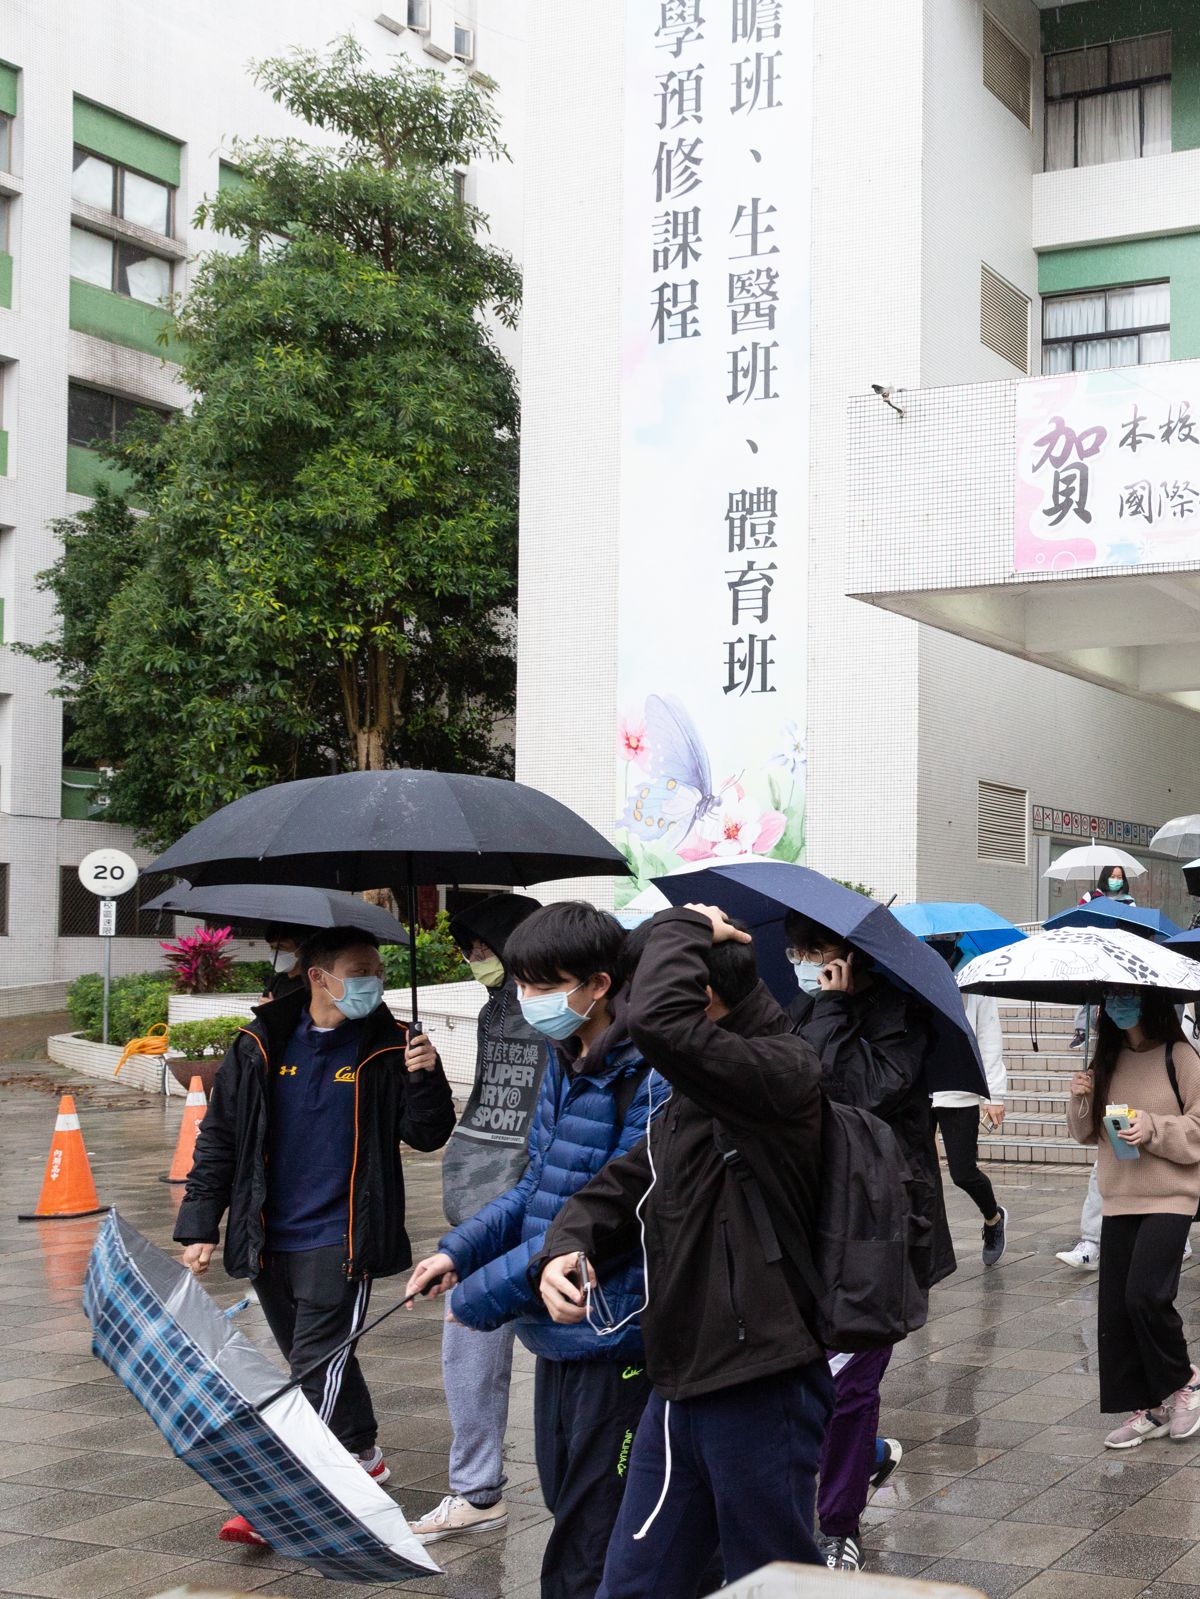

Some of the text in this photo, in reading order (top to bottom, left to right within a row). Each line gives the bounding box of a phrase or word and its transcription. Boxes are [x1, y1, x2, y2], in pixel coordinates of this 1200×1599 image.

[651, 0, 706, 345] 學預修課程
[1031, 415, 1107, 527] 賀
[93, 865, 125, 880] 20
[482, 1062, 536, 1088] UPER
[471, 1105, 528, 1132] SPORT
